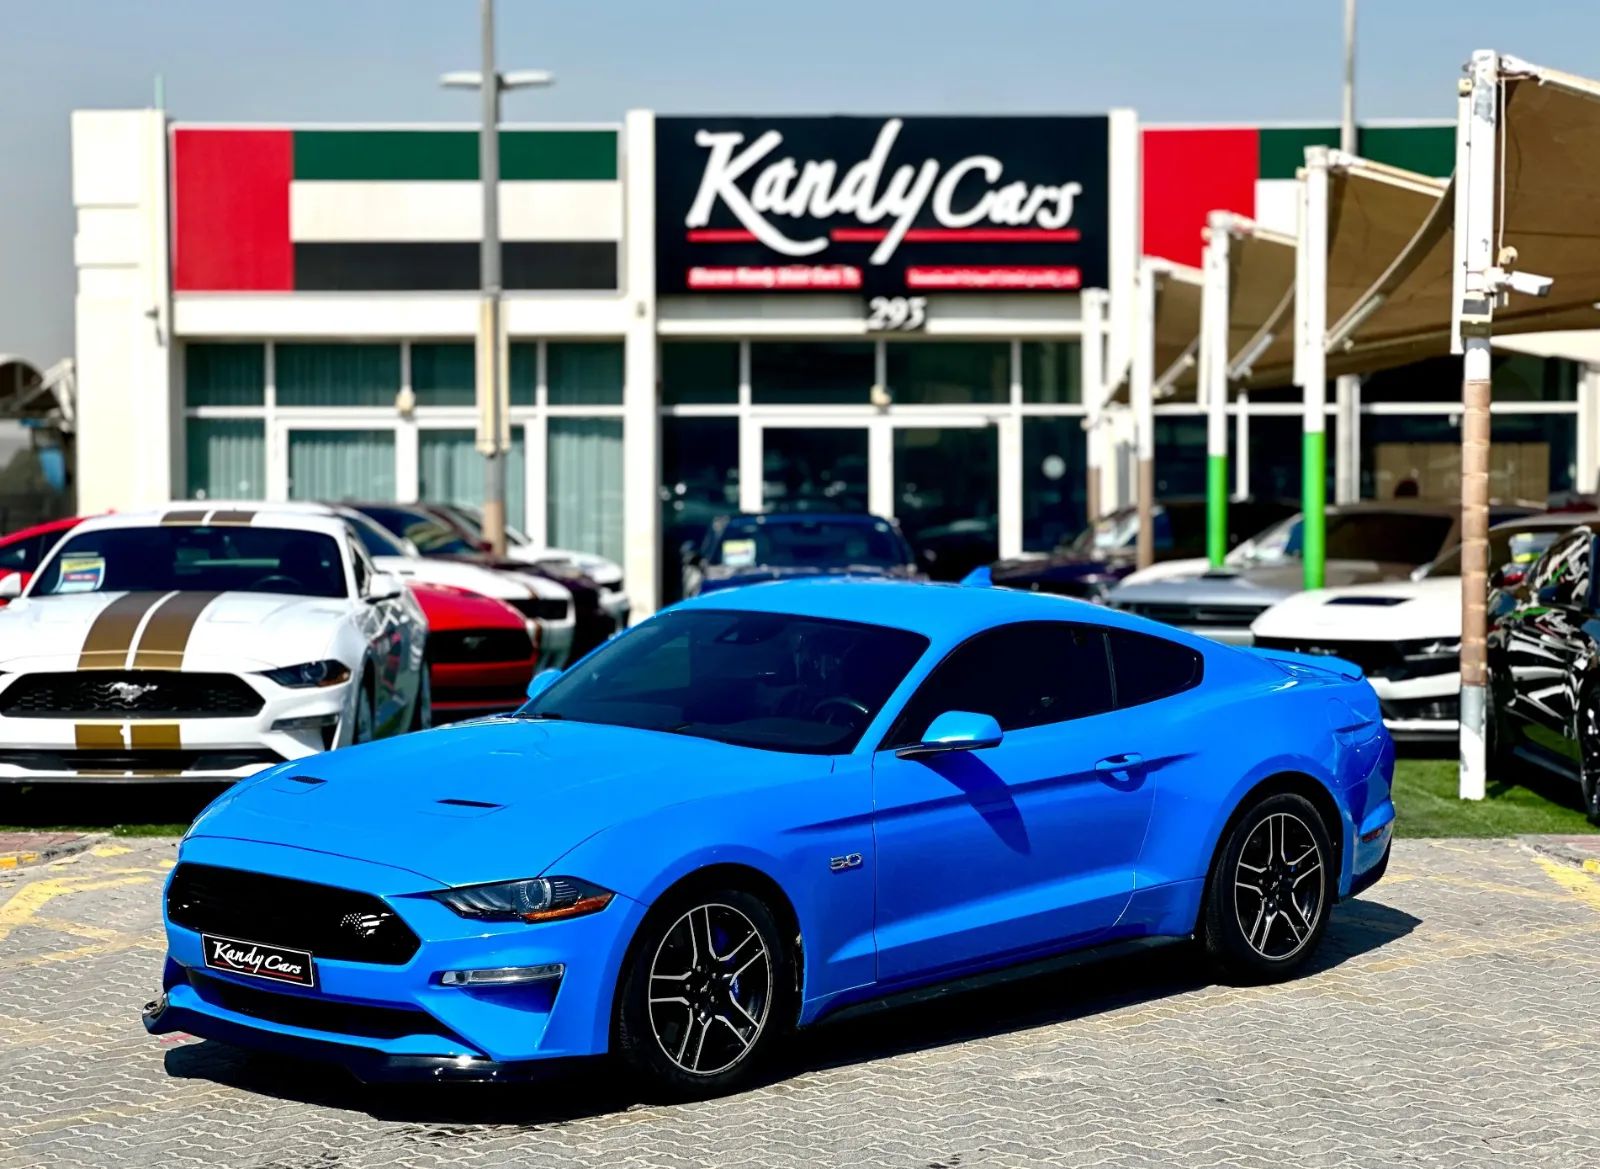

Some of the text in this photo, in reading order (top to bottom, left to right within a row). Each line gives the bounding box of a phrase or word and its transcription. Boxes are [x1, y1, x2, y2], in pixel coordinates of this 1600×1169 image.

[685, 118, 1082, 265] Kandy Cars
[869, 296, 927, 330] 295
[213, 941, 302, 974] Kandy Cars
